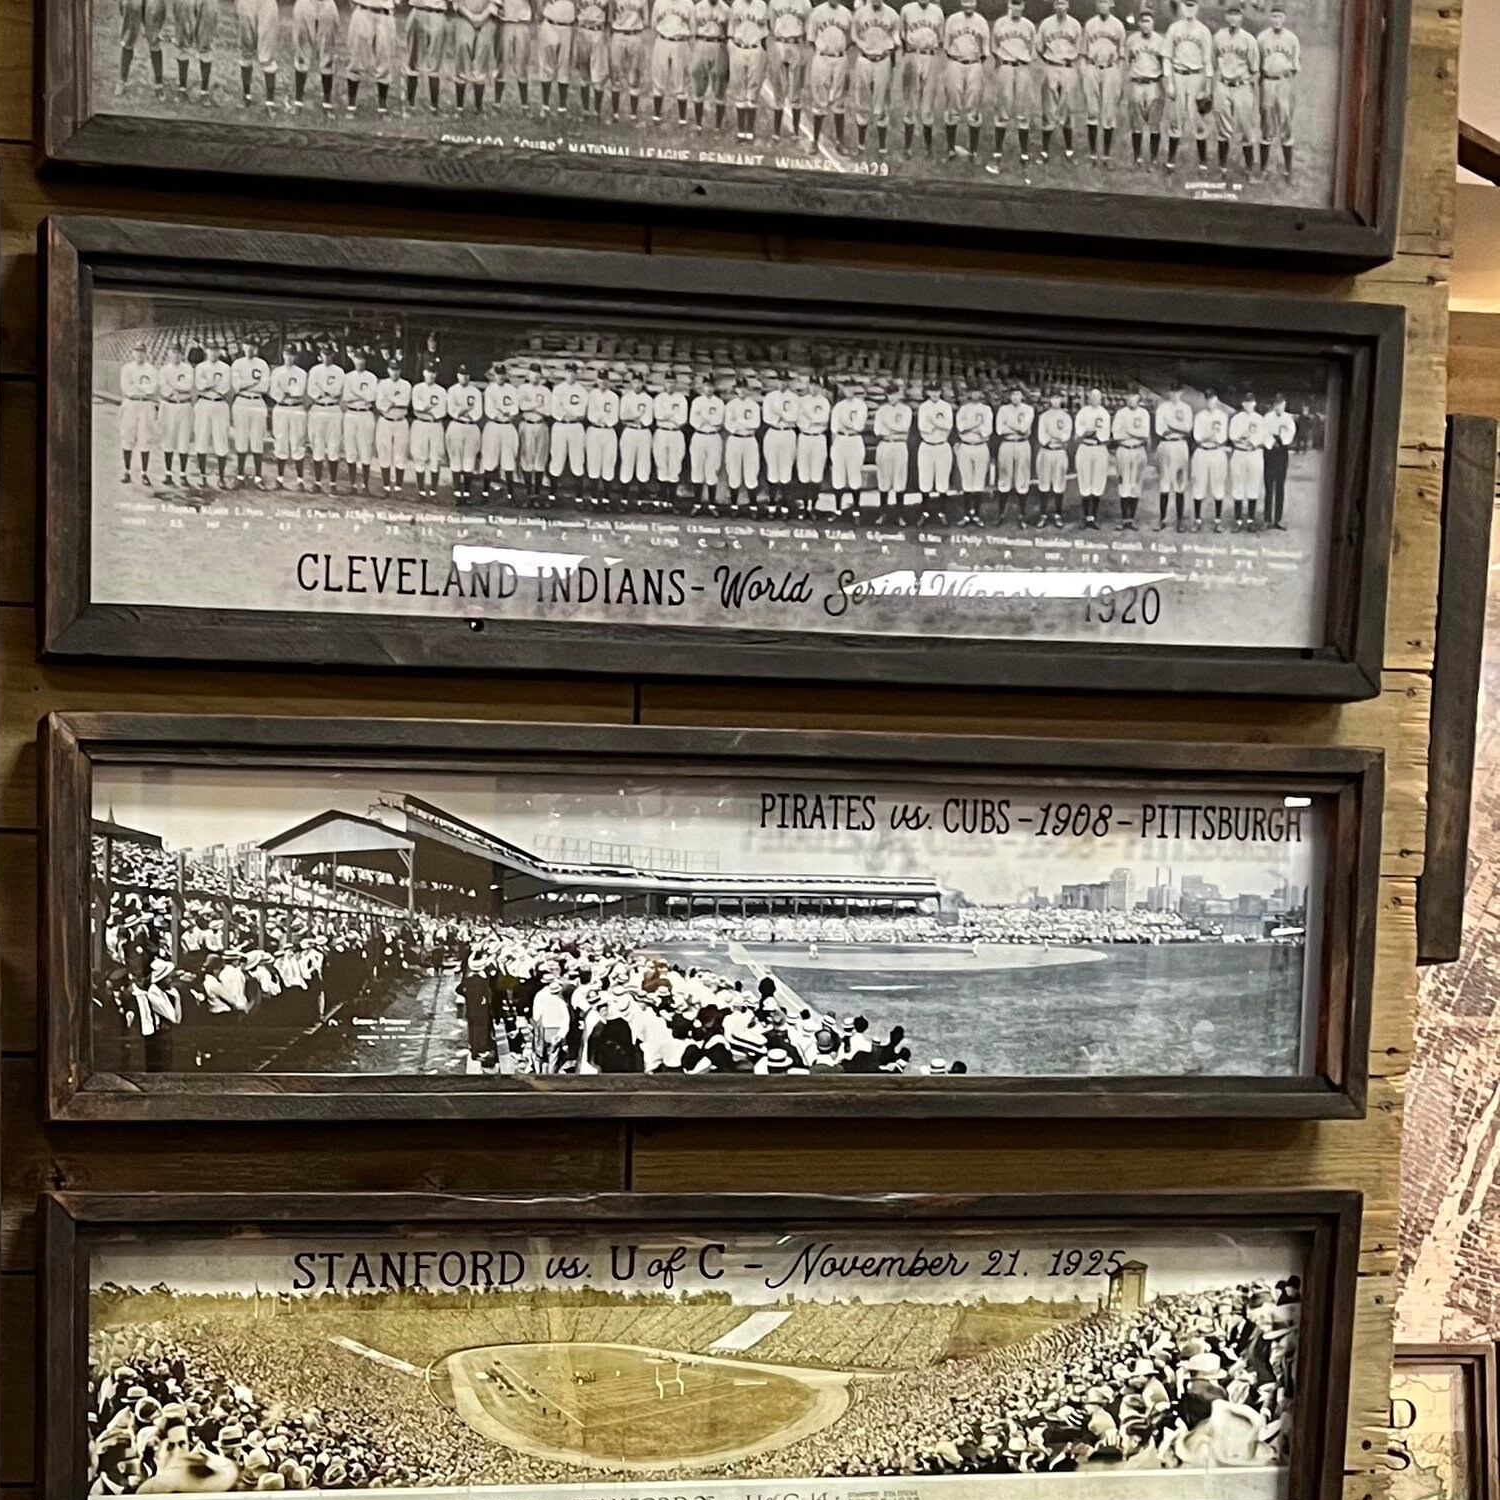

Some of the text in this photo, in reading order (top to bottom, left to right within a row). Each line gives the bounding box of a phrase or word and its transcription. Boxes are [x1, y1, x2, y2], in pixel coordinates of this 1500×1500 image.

[296, 552, 520, 599] CLEVELAND
[536, 565, 687, 607] INDIANS
[713, 565, 813, 610] World
[1081, 583, 1162, 625] 1920
[759, 793, 1305, 843] PIRATES vs. CUBS 1908 PITTSBURGH
[293, 1250, 526, 1290] STANFORD
[545, 1256, 593, 1280] vs.
[609, 1244, 637, 1281] U
[647, 1246, 687, 1290] of
[698, 1243, 726, 1281] C
[764, 1242, 970, 1290] November
[1046, 1249, 1123, 1278] 1925
